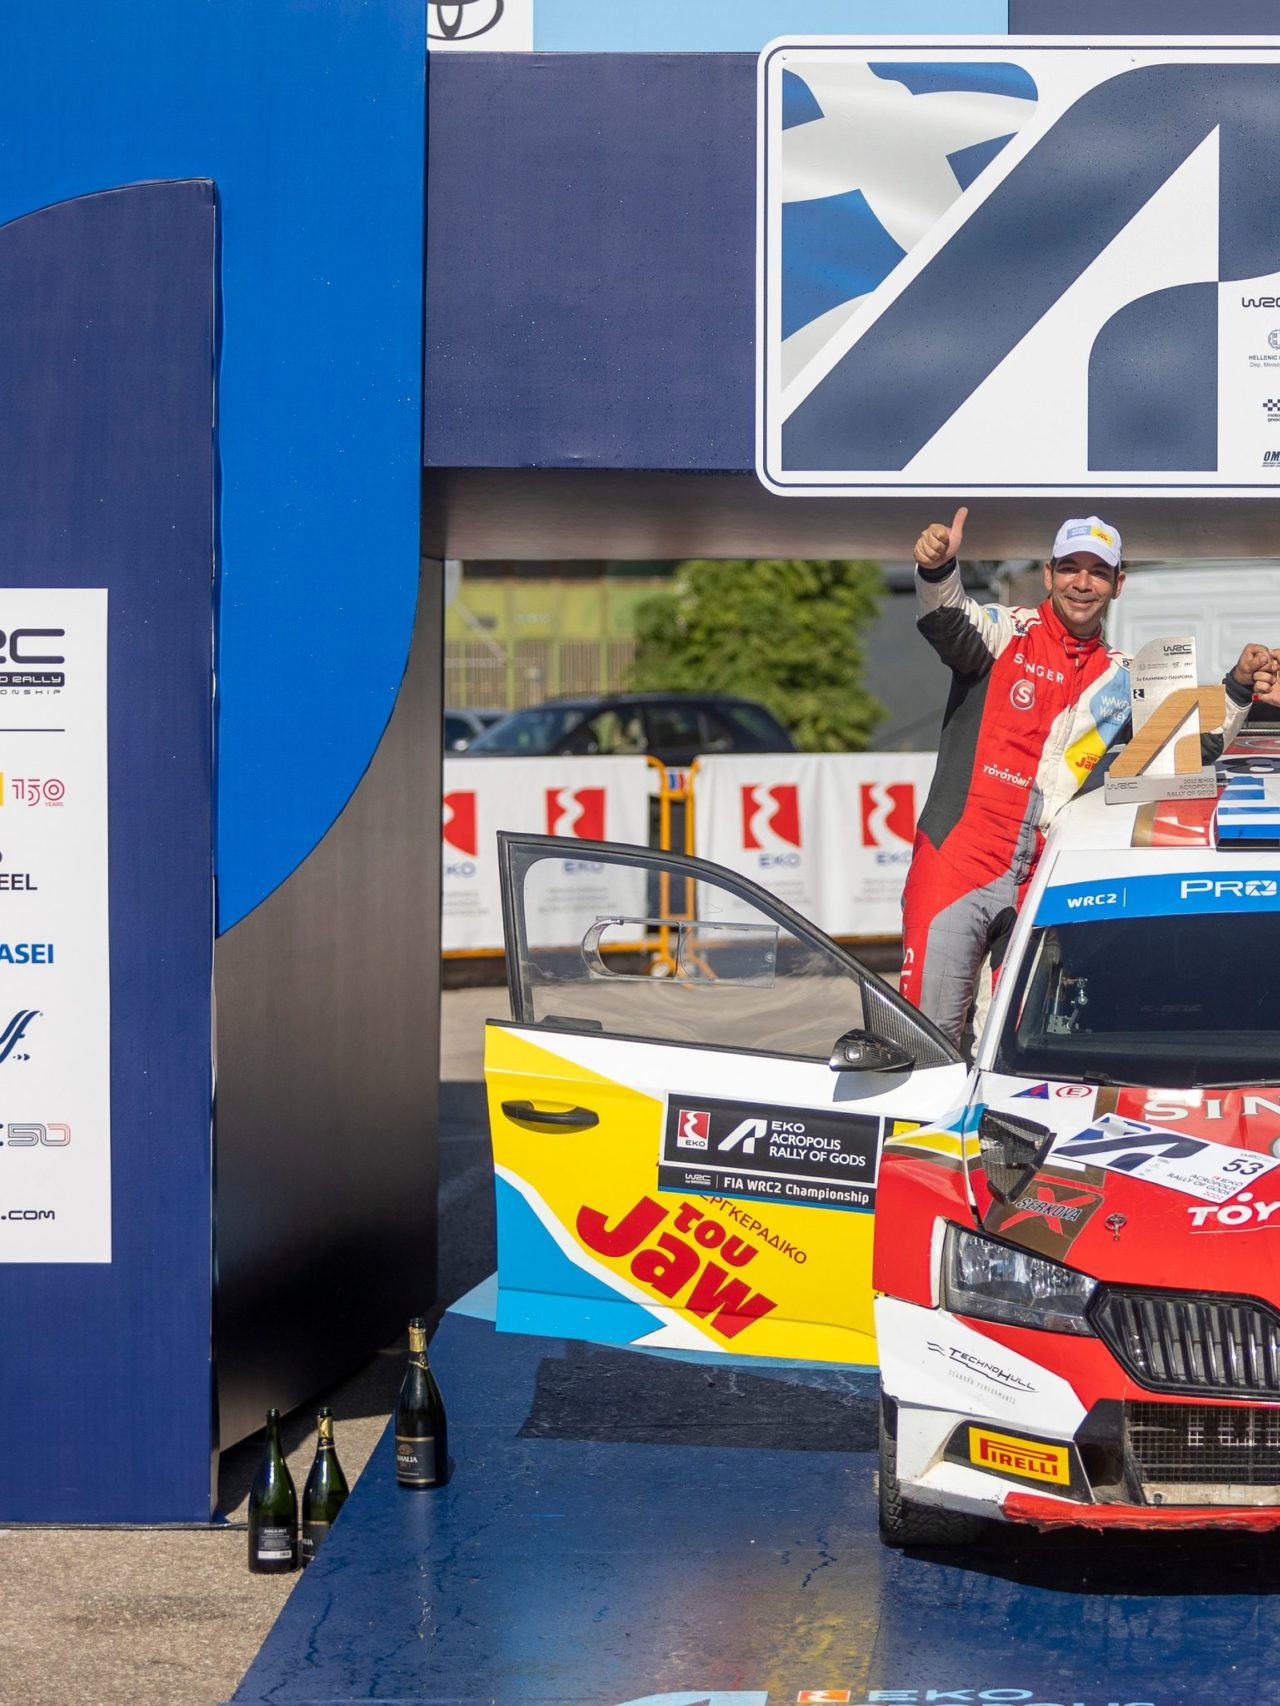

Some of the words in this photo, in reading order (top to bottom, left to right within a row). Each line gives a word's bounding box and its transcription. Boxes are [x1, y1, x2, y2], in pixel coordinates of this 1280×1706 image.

[1163, 644, 1192, 652] WRC
[1014, 653, 1065, 685] SNGER
[12, 676, 62, 684] RALLY
[759, 853, 801, 868] EKO
[1067, 893, 1118, 909] WRC2
[772, 1121, 805, 1133] EKO
[685, 1140, 706, 1148] EKO
[770, 1134, 841, 1151] ACROPOLIS
[770, 1146, 808, 1160] RALLY
[809, 1150, 828, 1163] OF
[829, 1153, 867, 1168] GODS
[1222, 1158, 1265, 1176] 53
[685, 1173, 711, 1181] WRC
[723, 1176, 744, 1189] FIA
[747, 1179, 782, 1194] WRC2
[785, 1183, 870, 1206] Championship
[1016, 1197, 1083, 1222] SERKOVA
[576, 1195, 779, 1340] Jaw
[979, 1437, 1059, 1477] PIRELLI
[868, 1688, 1034, 1702] EKO
